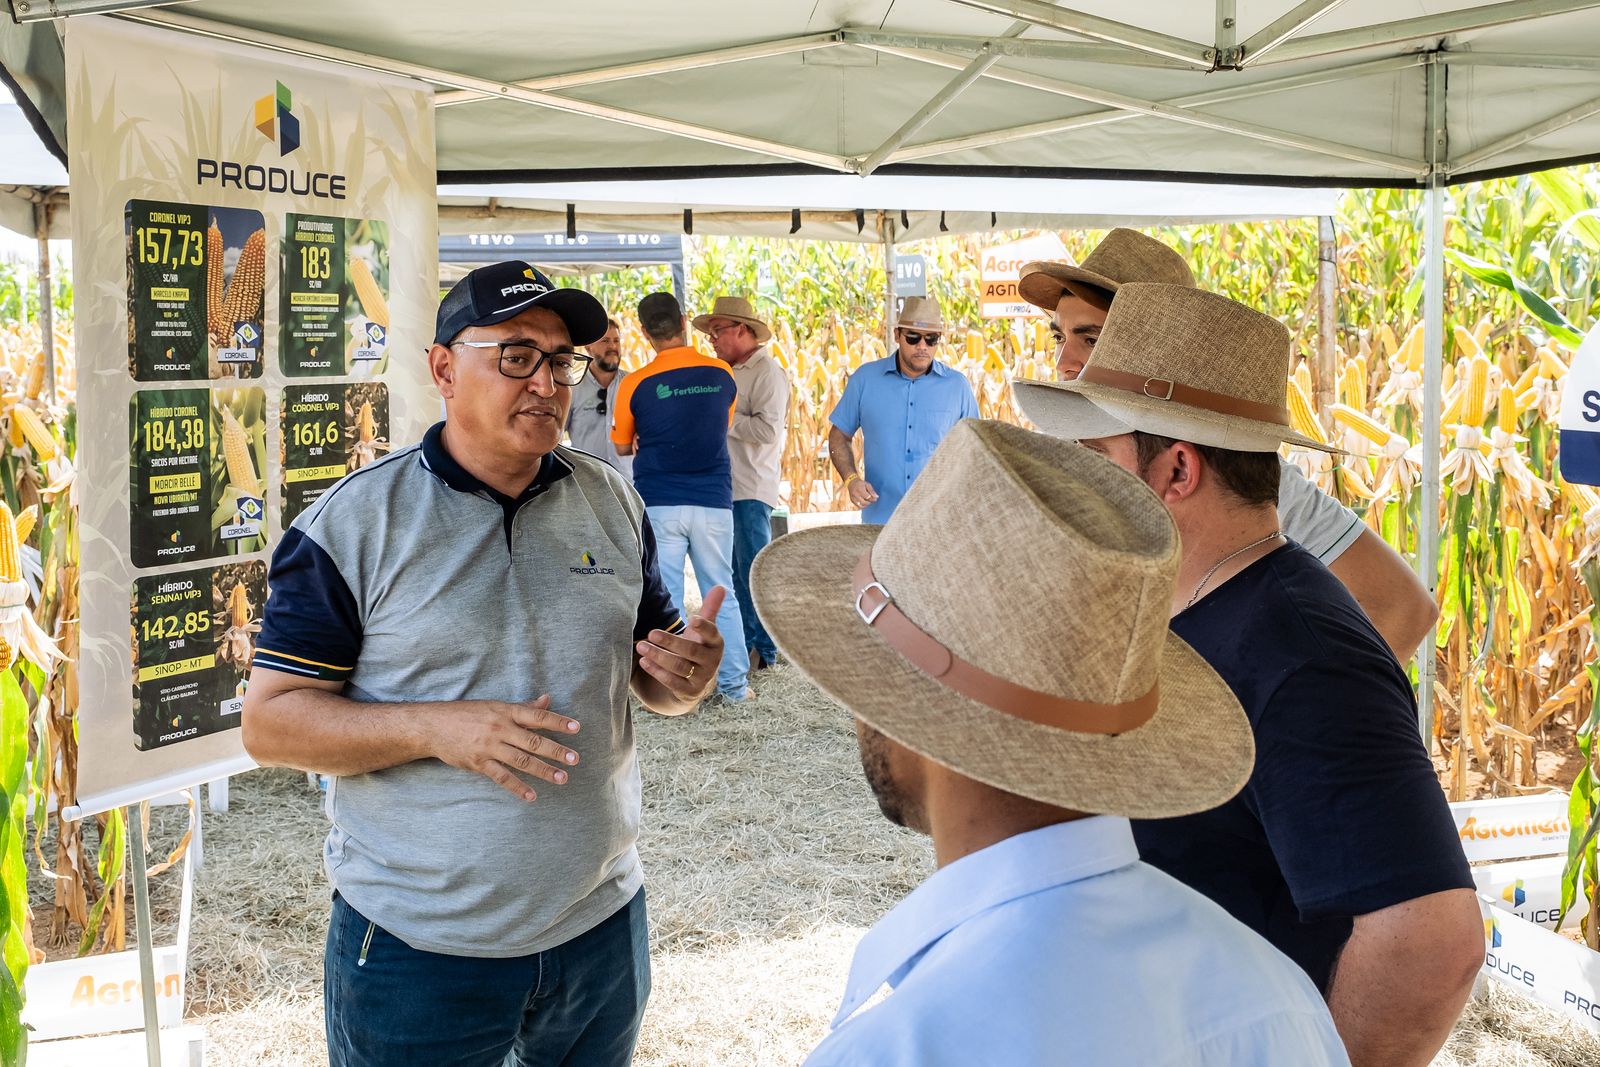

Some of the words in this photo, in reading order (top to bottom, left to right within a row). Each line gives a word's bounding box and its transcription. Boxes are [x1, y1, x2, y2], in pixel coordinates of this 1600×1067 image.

[197, 158, 346, 200] PRODUCE
[150, 212, 176, 224] CORONEL
[177, 214, 191, 225] VIP3
[469, 234, 515, 245] TEVO
[617, 234, 661, 245] TEVO
[136, 227, 203, 270] 157,73
[300, 246, 330, 279] 183
[301, 393, 329, 403] HÍBRIDO
[150, 406, 173, 418] HÍBRIDO
[174, 406, 198, 417] CORONEL
[292, 403, 324, 412] CORONEL
[325, 403, 340, 411] VIP3
[144, 418, 204, 454] 184,38
[293, 421, 338, 447] 161,6
[168, 456, 178, 466] POR
[298, 469, 319, 478] SINOP
[325, 467, 335, 476] MT
[154, 478, 179, 490] MOACIR
[154, 494, 168, 505] NOVA
[228, 527, 252, 536] CORONEL
[158, 580, 193, 594] HÍBRIDO
[184, 590, 202, 600] VIP3
[142, 610, 210, 642] 142,85
[169, 639, 185, 650] SC/HA
[155, 662, 181, 676] SINOP
[190, 658, 202, 669] MT
